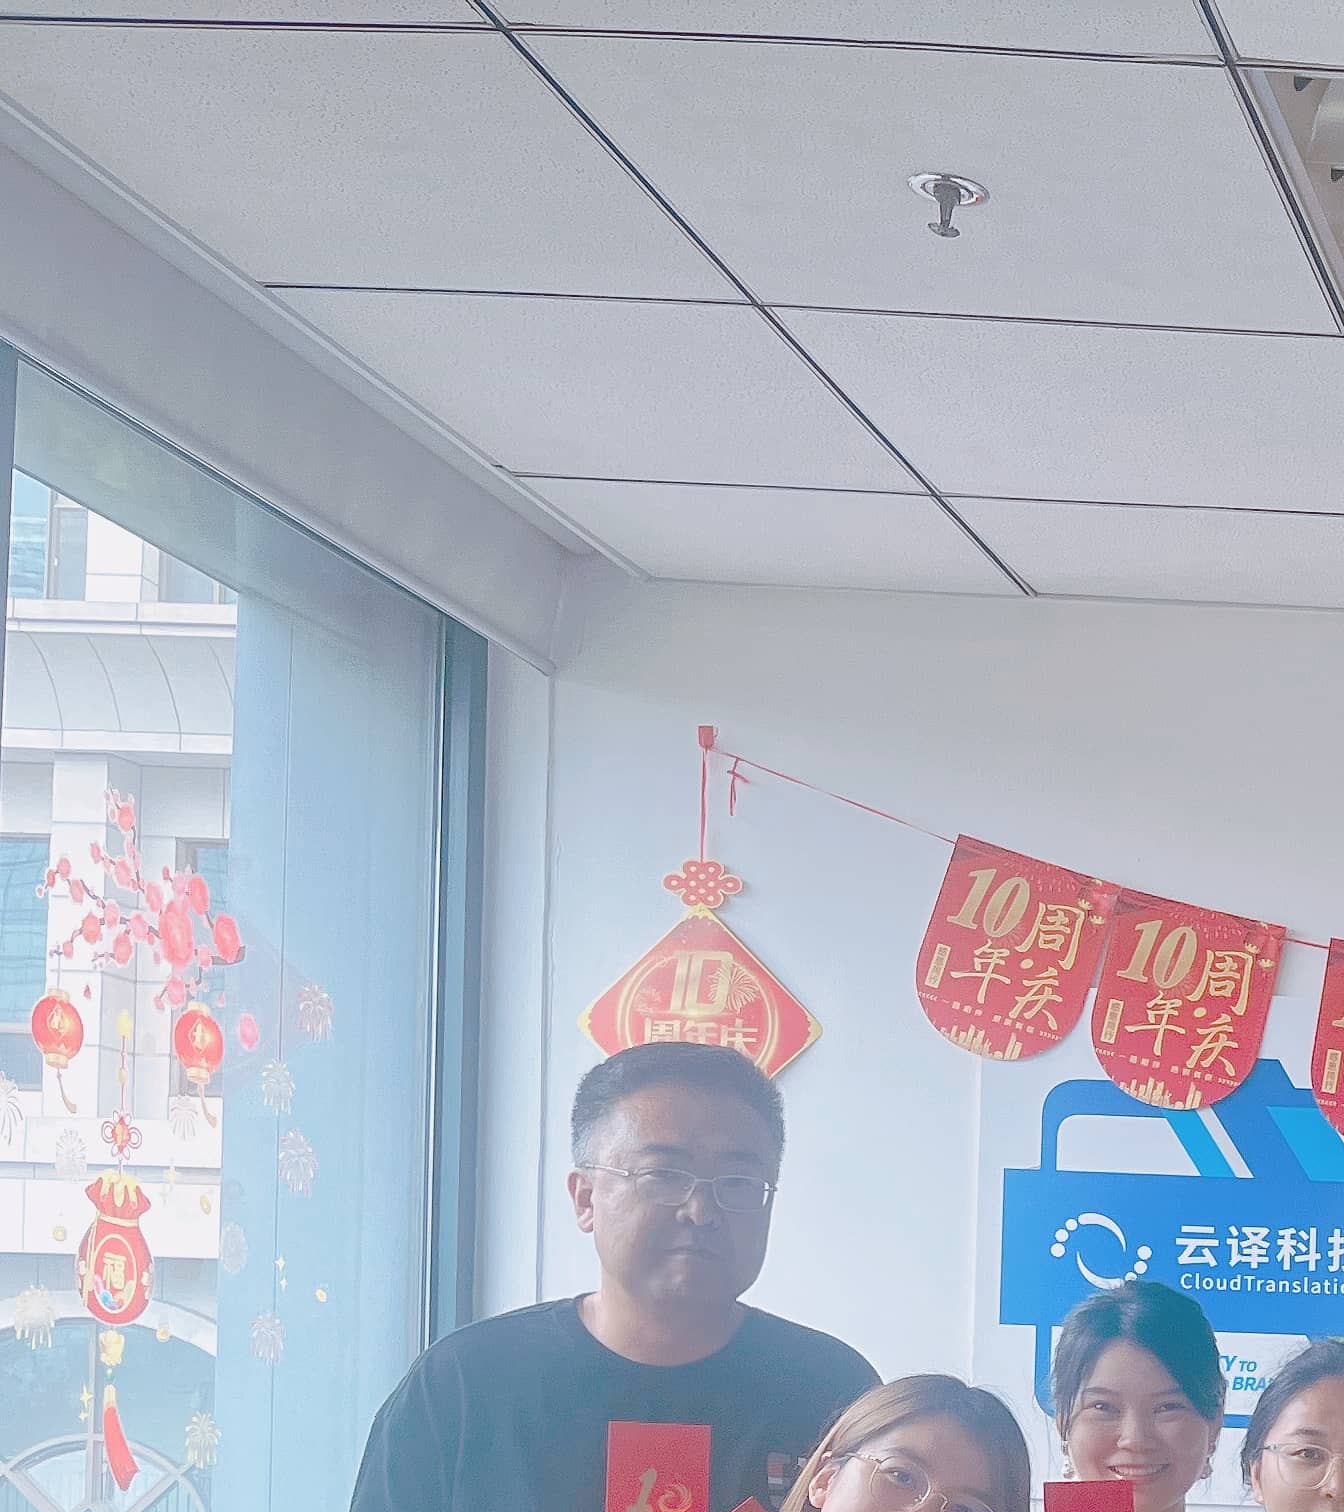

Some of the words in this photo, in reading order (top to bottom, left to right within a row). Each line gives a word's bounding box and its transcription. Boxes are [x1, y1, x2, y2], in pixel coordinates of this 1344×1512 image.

[671, 950, 734, 1015] 10
[103, 1251, 127, 1291] 福
[1239, 1361, 1257, 1372] TO
[1232, 1376, 1266, 1391] BRA
